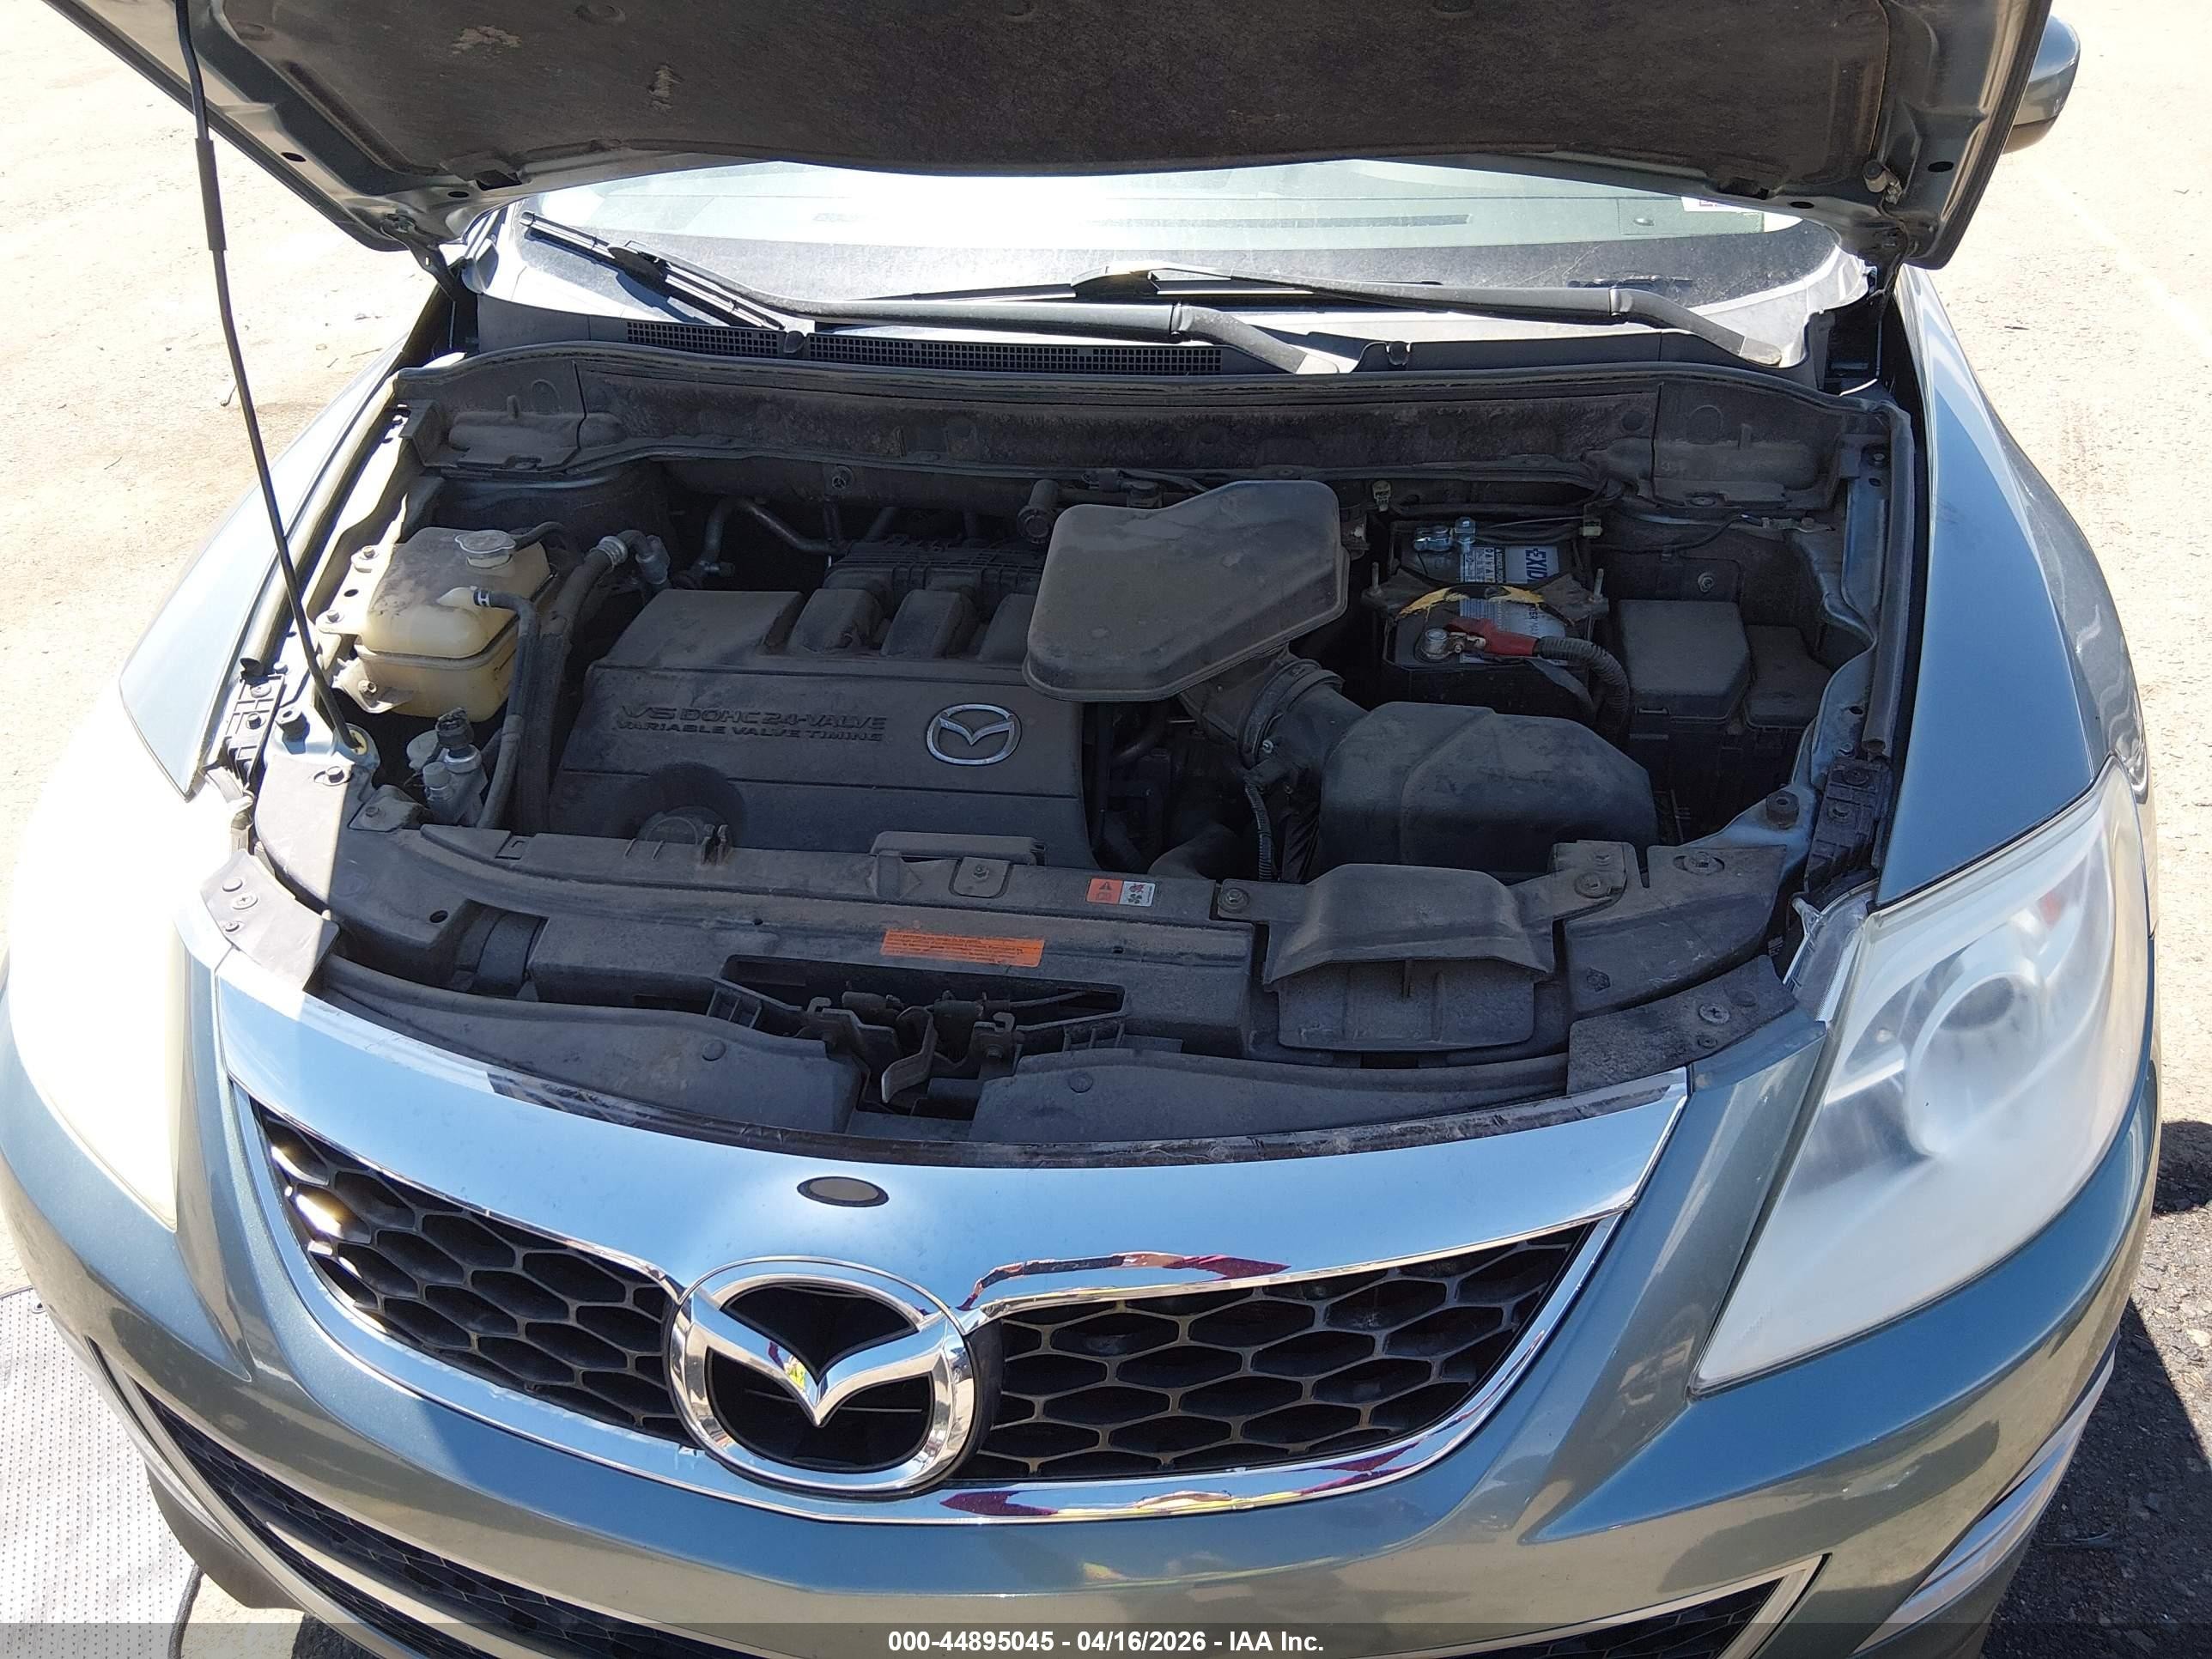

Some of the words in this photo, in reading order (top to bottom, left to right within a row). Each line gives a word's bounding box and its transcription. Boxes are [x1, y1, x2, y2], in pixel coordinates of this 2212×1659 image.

[1525, 548, 1547, 584] EXID
[679, 708, 761, 725] DOHC
[762, 712, 887, 730] 24-VALVE
[617, 720, 726, 735] VARIABLE
[732, 726, 801, 738] VALVE
[805, 730, 884, 742] TIMING
